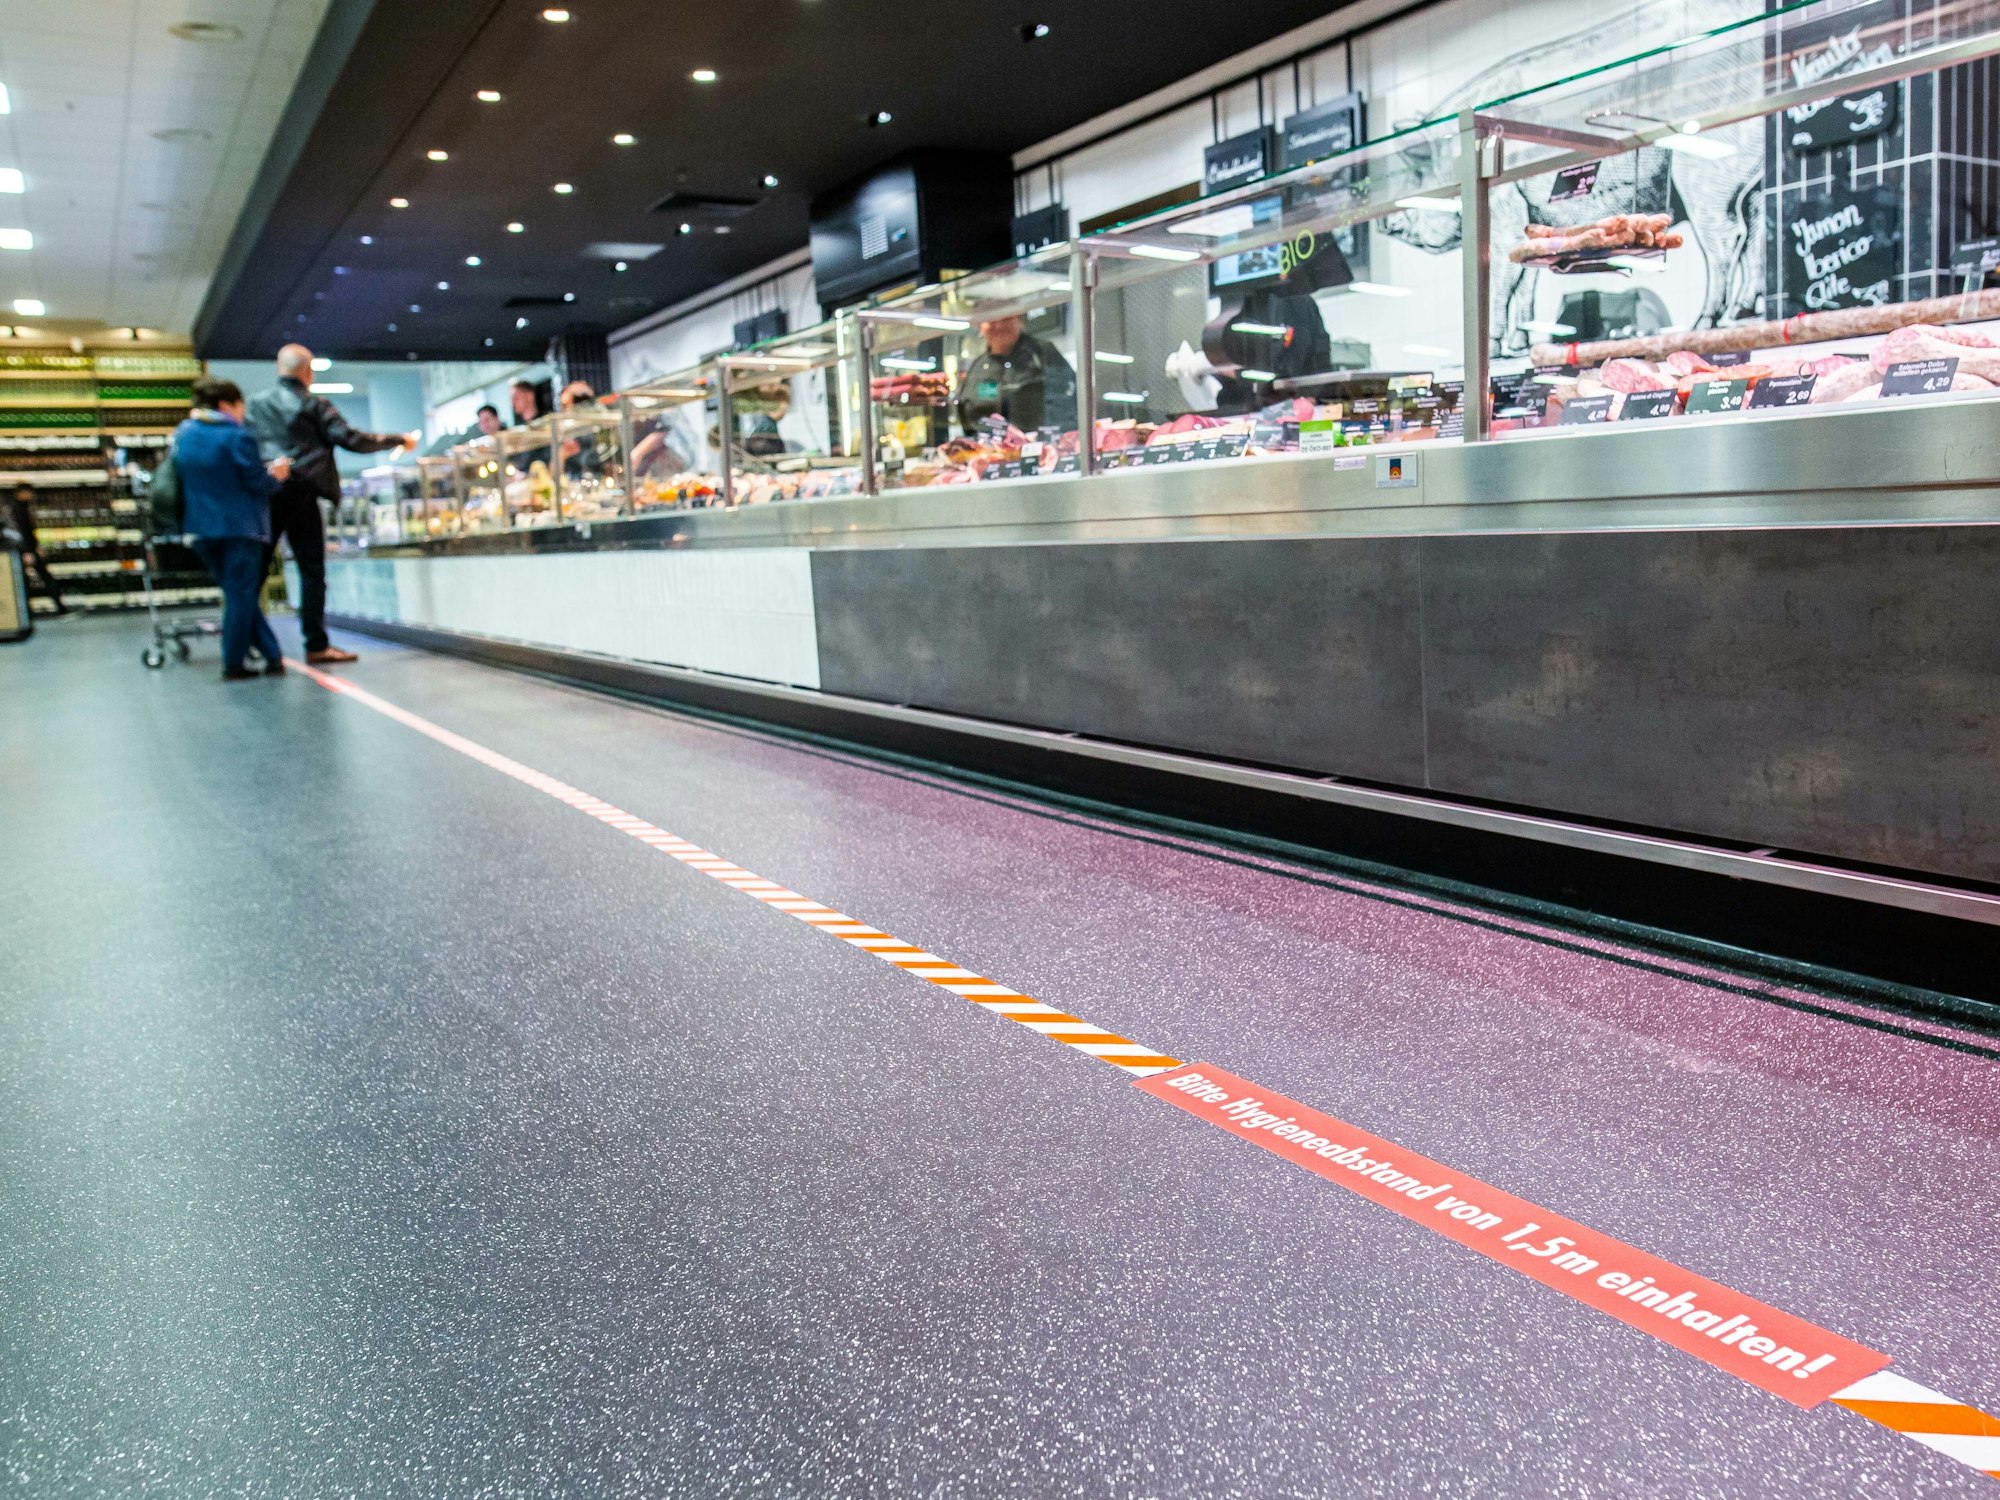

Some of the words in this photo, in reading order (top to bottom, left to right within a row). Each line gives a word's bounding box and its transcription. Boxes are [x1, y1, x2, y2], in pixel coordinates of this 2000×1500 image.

[1278, 228, 1315, 274] BIO
[1785, 391, 1810, 404] 2.69
[1165, 1073, 1227, 1103] Bitte
[1219, 1097, 1449, 1201] Hygieneabstand
[1434, 1196, 1503, 1231] von
[1500, 1222, 1600, 1276] 1,5m
[1597, 1270, 1837, 1380] einhalten!
